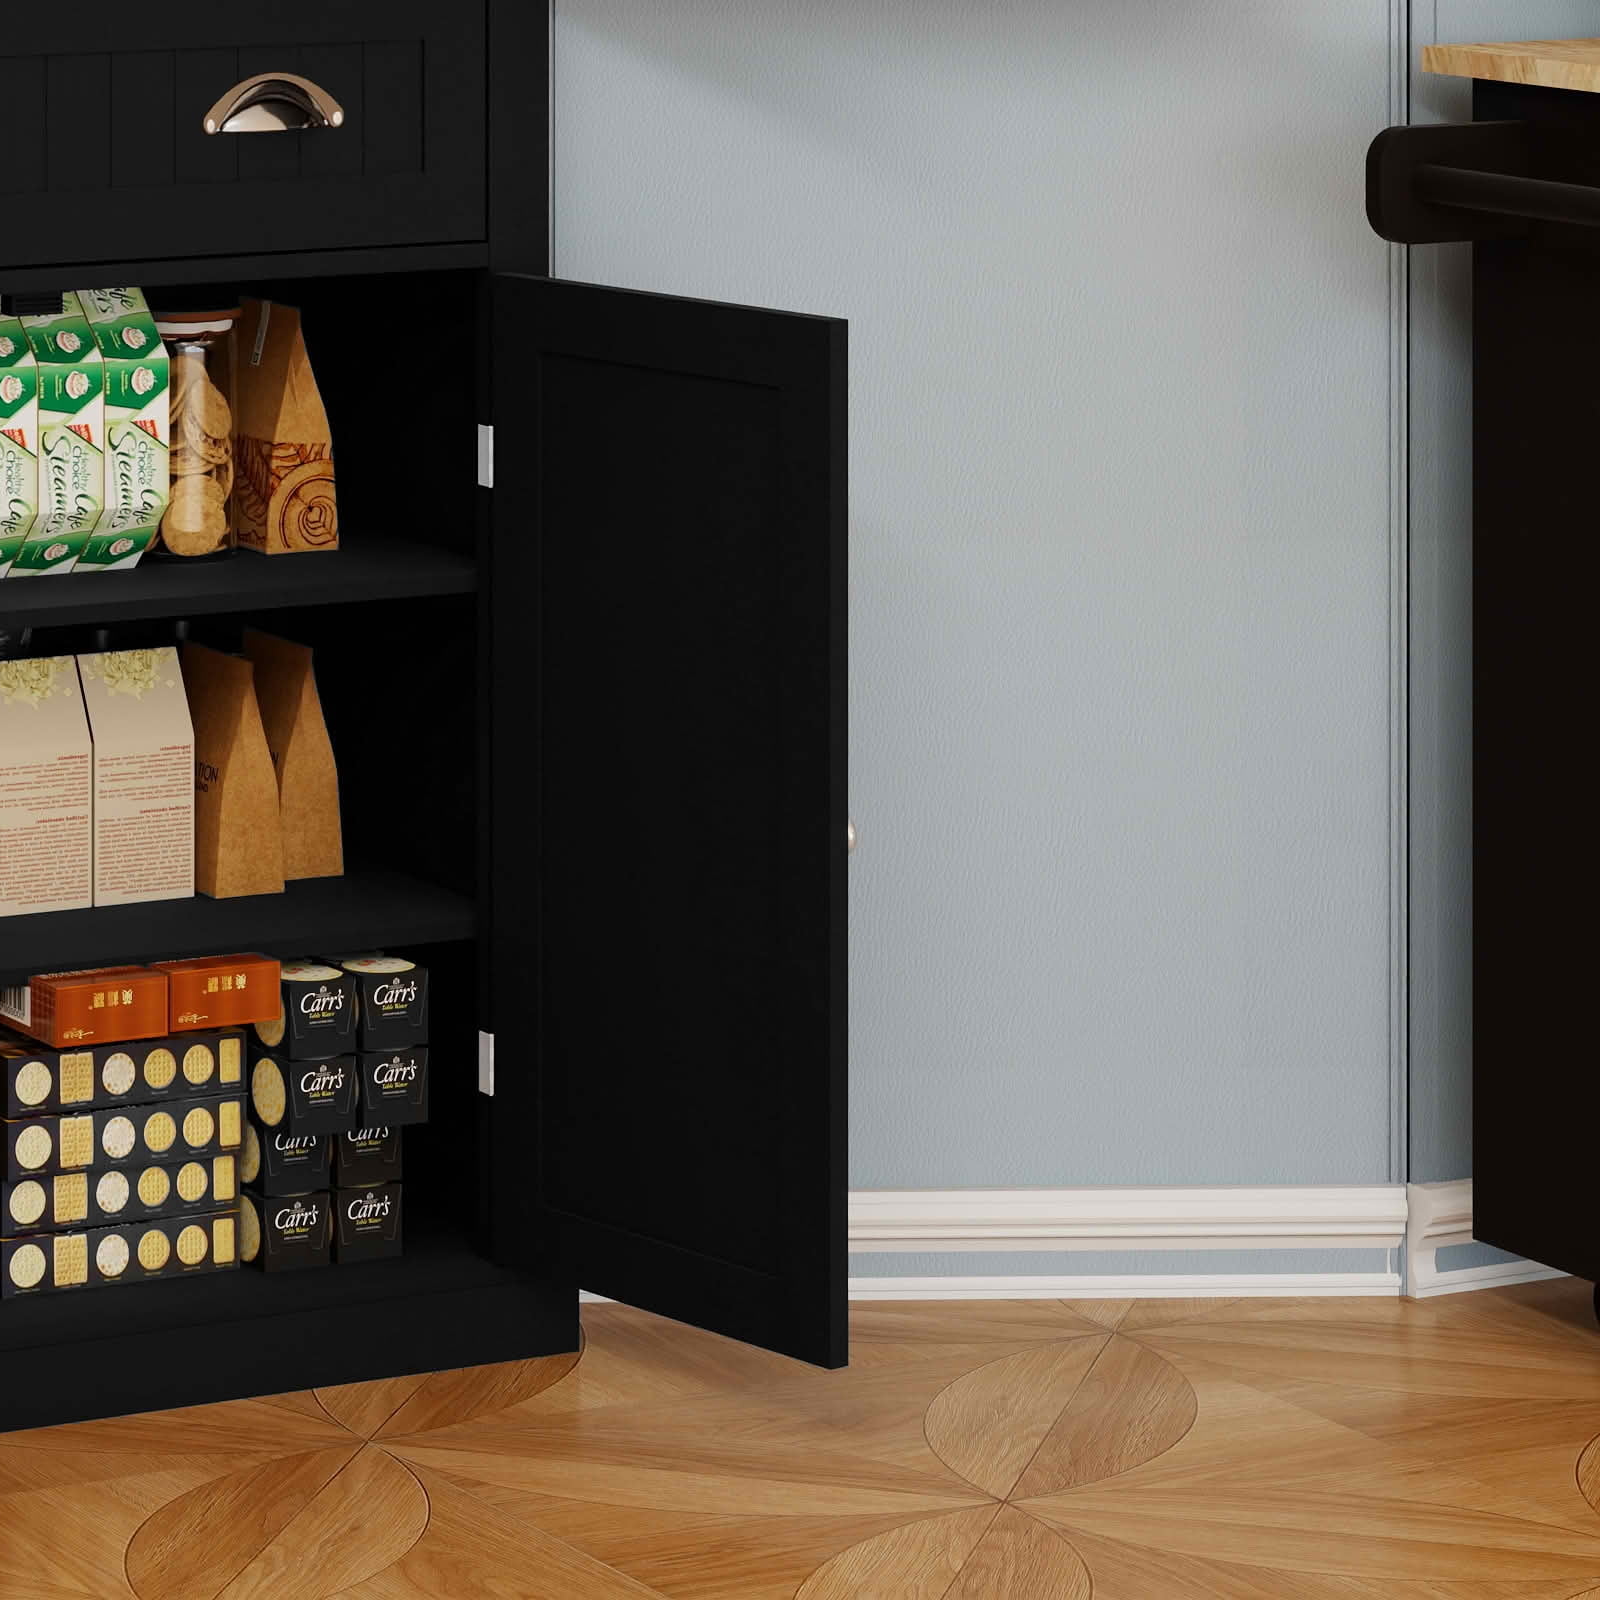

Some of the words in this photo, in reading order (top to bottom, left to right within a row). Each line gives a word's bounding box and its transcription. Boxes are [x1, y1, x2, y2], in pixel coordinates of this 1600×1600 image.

[6, 450, 16, 495] Choice
[72, 445, 82, 490] Choice
[138, 441, 148, 485] Choice
[42, 432, 71, 533] Steamers
[108, 426, 137, 528] Steamers
[300, 989, 344, 1013] Carr's
[374, 981, 418, 1005] Carr's
[300, 1068, 344, 1093] Carr's
[374, 1060, 417, 1084] Carr's
[275, 1205, 319, 1229] Carr's
[347, 1195, 391, 1220] Carr's
